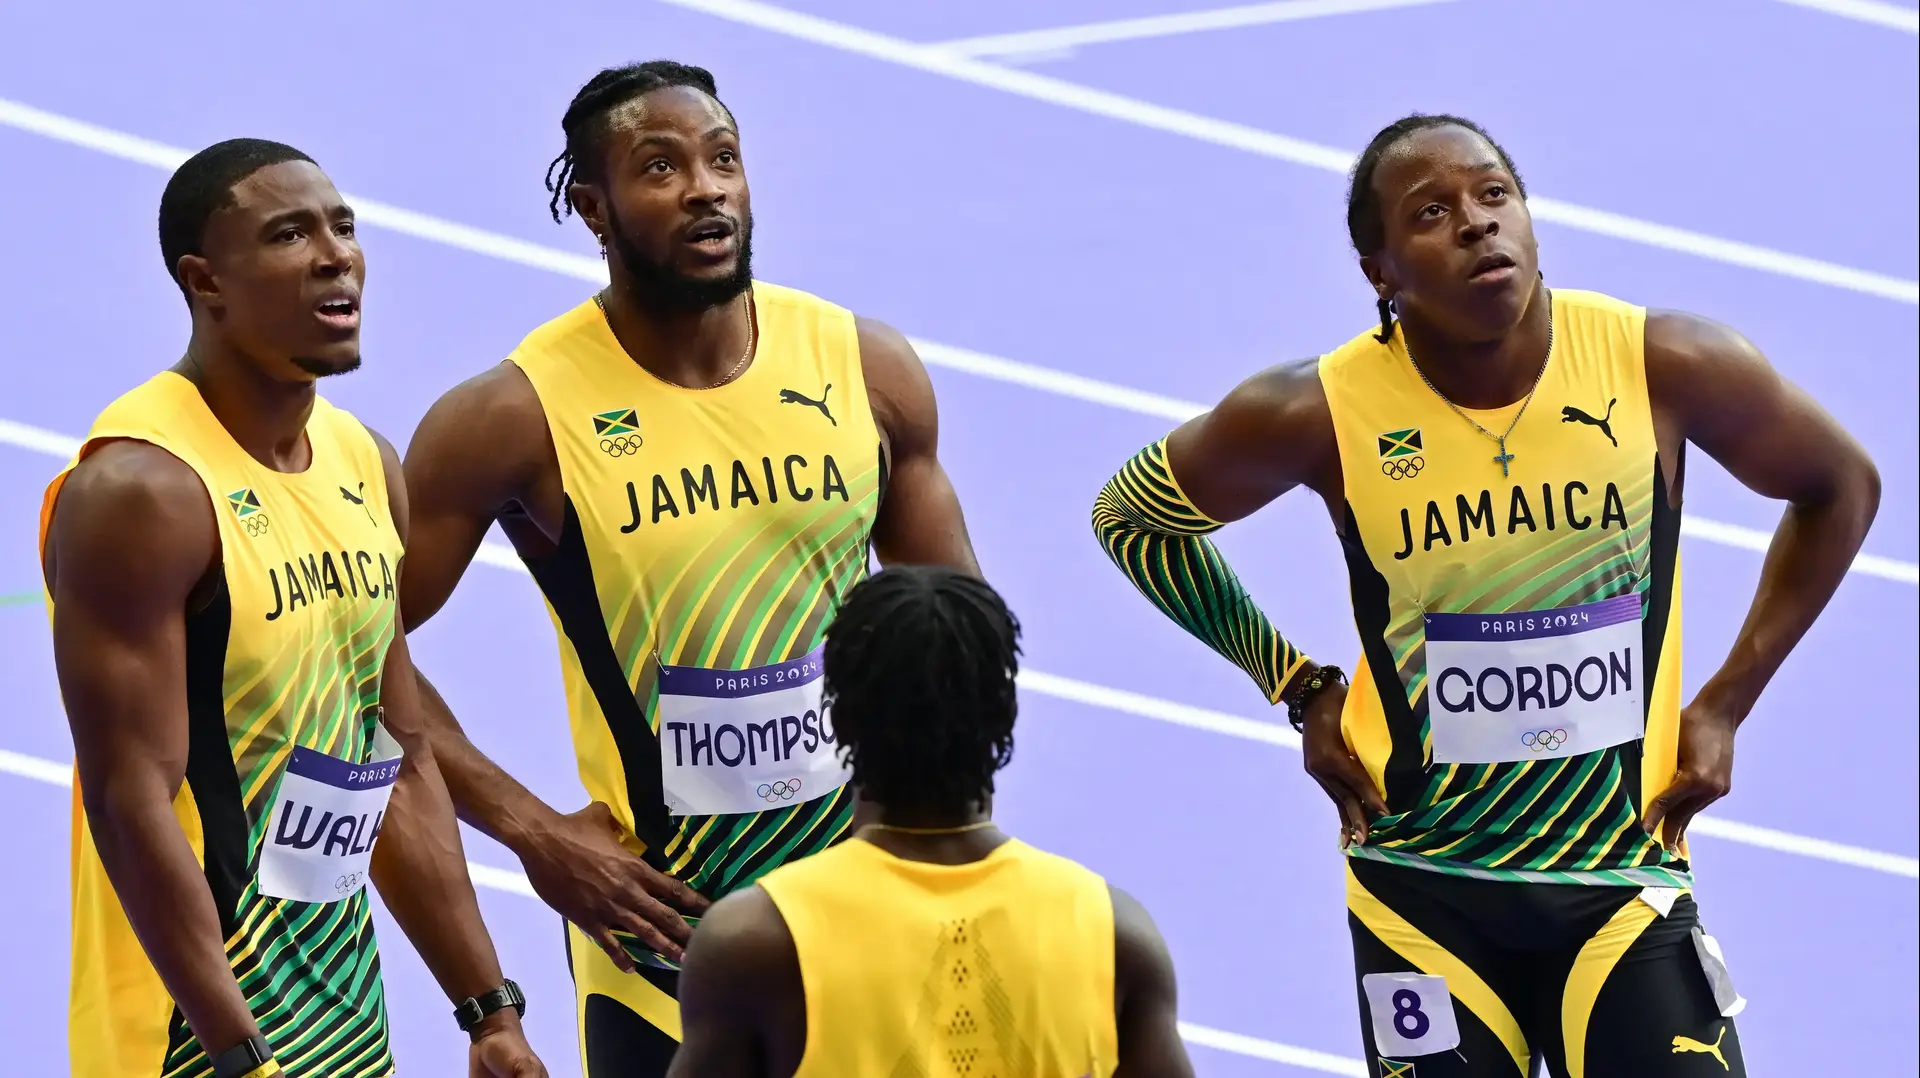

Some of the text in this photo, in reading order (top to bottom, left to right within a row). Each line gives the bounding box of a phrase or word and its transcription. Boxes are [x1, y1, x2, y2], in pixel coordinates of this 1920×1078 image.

[620, 454, 849, 534] JAMAICA
[1394, 481, 1628, 560] JAMAICA
[265, 551, 395, 621] JAMAICA
[1542, 611, 1589, 629] 2024
[775, 661, 817, 683] 2024
[1436, 647, 1632, 713] GORDON
[1392, 989, 1430, 1040] 8
